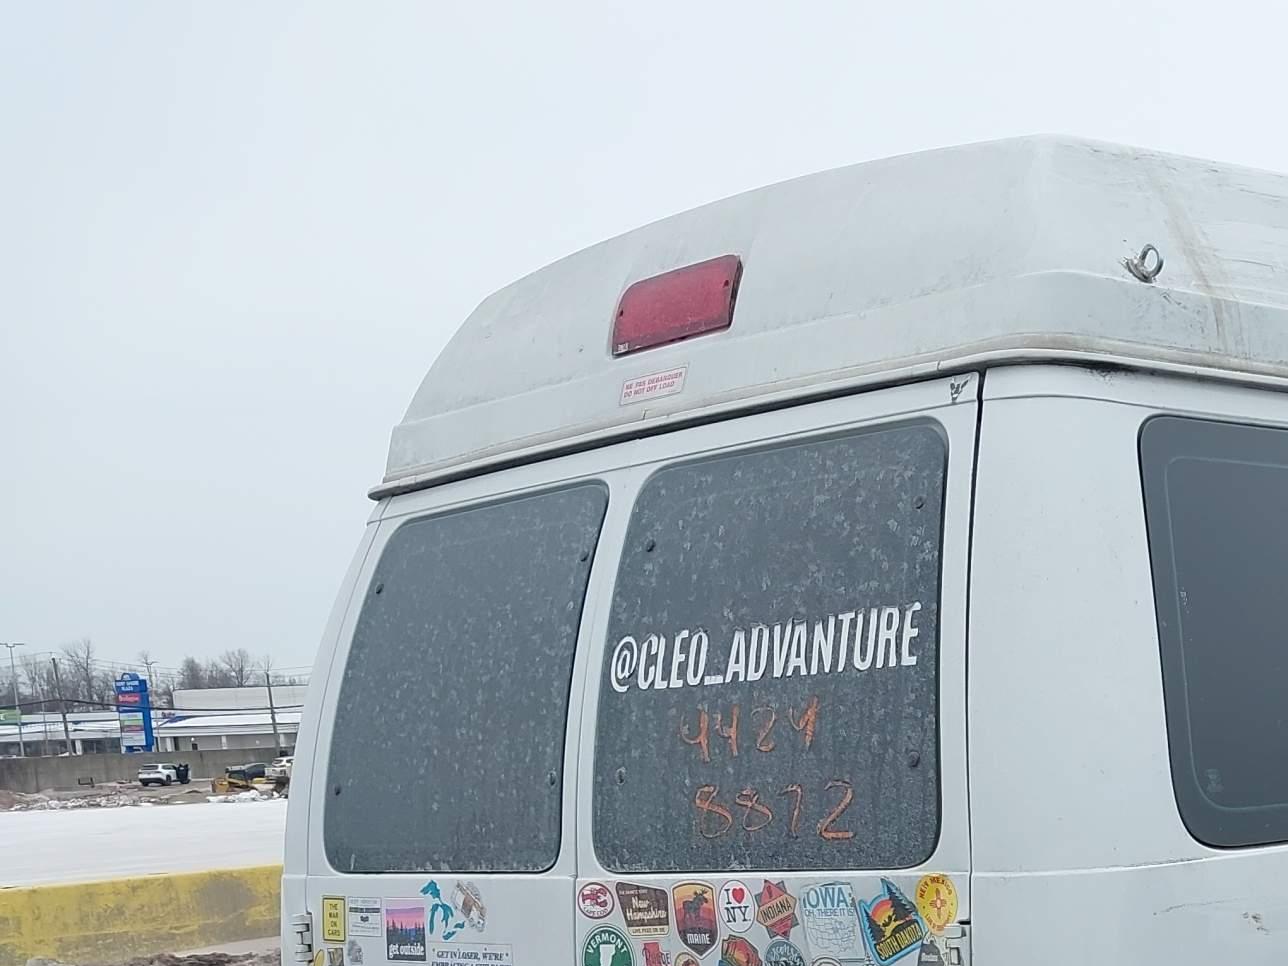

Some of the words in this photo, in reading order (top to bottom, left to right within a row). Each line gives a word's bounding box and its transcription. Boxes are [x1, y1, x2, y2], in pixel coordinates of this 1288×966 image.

[610, 602, 922, 692] @CLEO_ADVANTURE
[919, 881, 929, 899] NEW
[930, 876, 953, 896] MEXICO
[631, 896, 650, 909] New
[723, 888, 733, 905] I
[329, 903, 338, 911] THE
[626, 906, 668, 923] Hampshire
[760, 899, 793, 923] INDIANA
[330, 920, 338, 928] ON
[327, 929, 340, 937] CARS
[686, 933, 711, 945] MAINE
[876, 936, 898, 960] SOUTH
[898, 923, 923, 950] DAKOTA
[388, 943, 399, 959] get
[400, 941, 425, 956] outside
[586, 932, 628, 954] VERMONT
[437, 950, 449, 959] GET
[450, 951, 457, 959] IN
